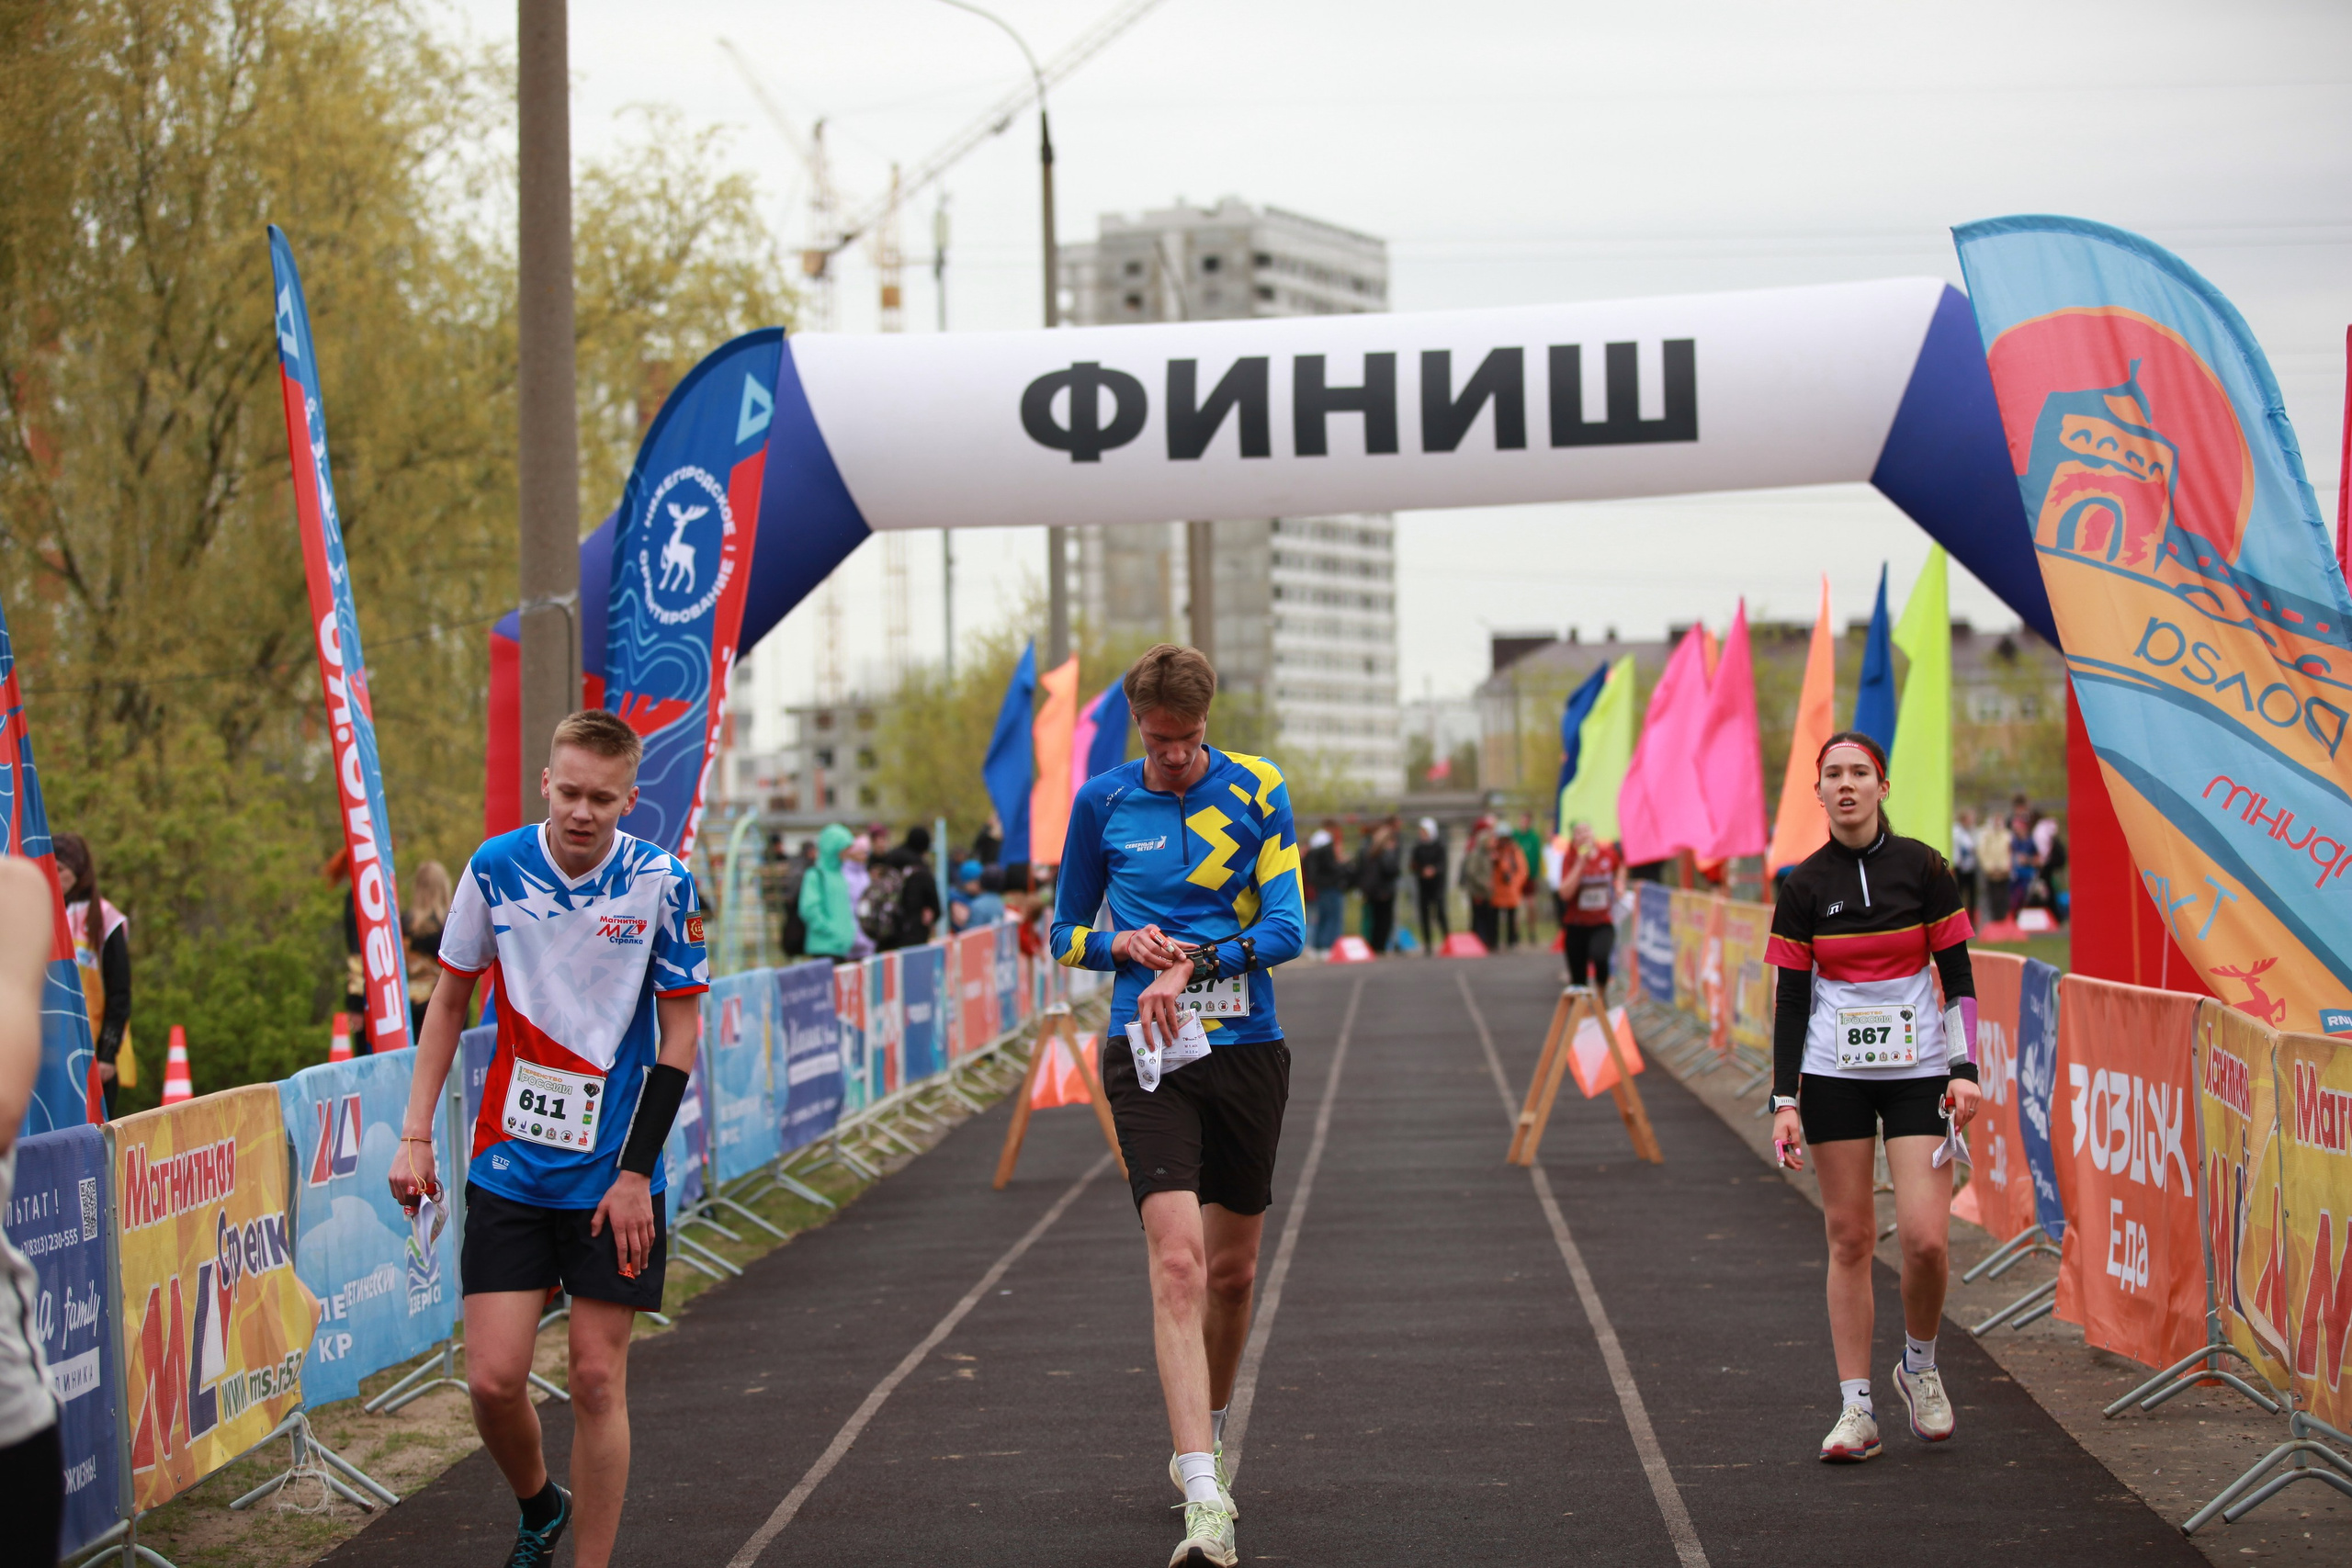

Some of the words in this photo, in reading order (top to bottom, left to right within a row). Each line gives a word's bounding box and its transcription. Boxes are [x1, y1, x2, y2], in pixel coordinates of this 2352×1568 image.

[1020, 337, 1699, 463] ФИНИШ
[1125, 840, 1154, 850] СЕВЕРНЫЙ
[600, 916, 648, 925] Магнитная
[1843, 1015, 1893, 1025] РОССИИ
[1848, 1027, 1891, 1045] 867
[521, 1073, 573, 1095] РОССИИ
[519, 1089, 566, 1120] 611
[2295, 1058, 2352, 1157] Маг
[492, 1154, 510, 1167] STG
[124, 1137, 236, 1234] Магнитная
[2107, 1197, 2149, 1295] Еда
[62, 1279, 100, 1350] family
